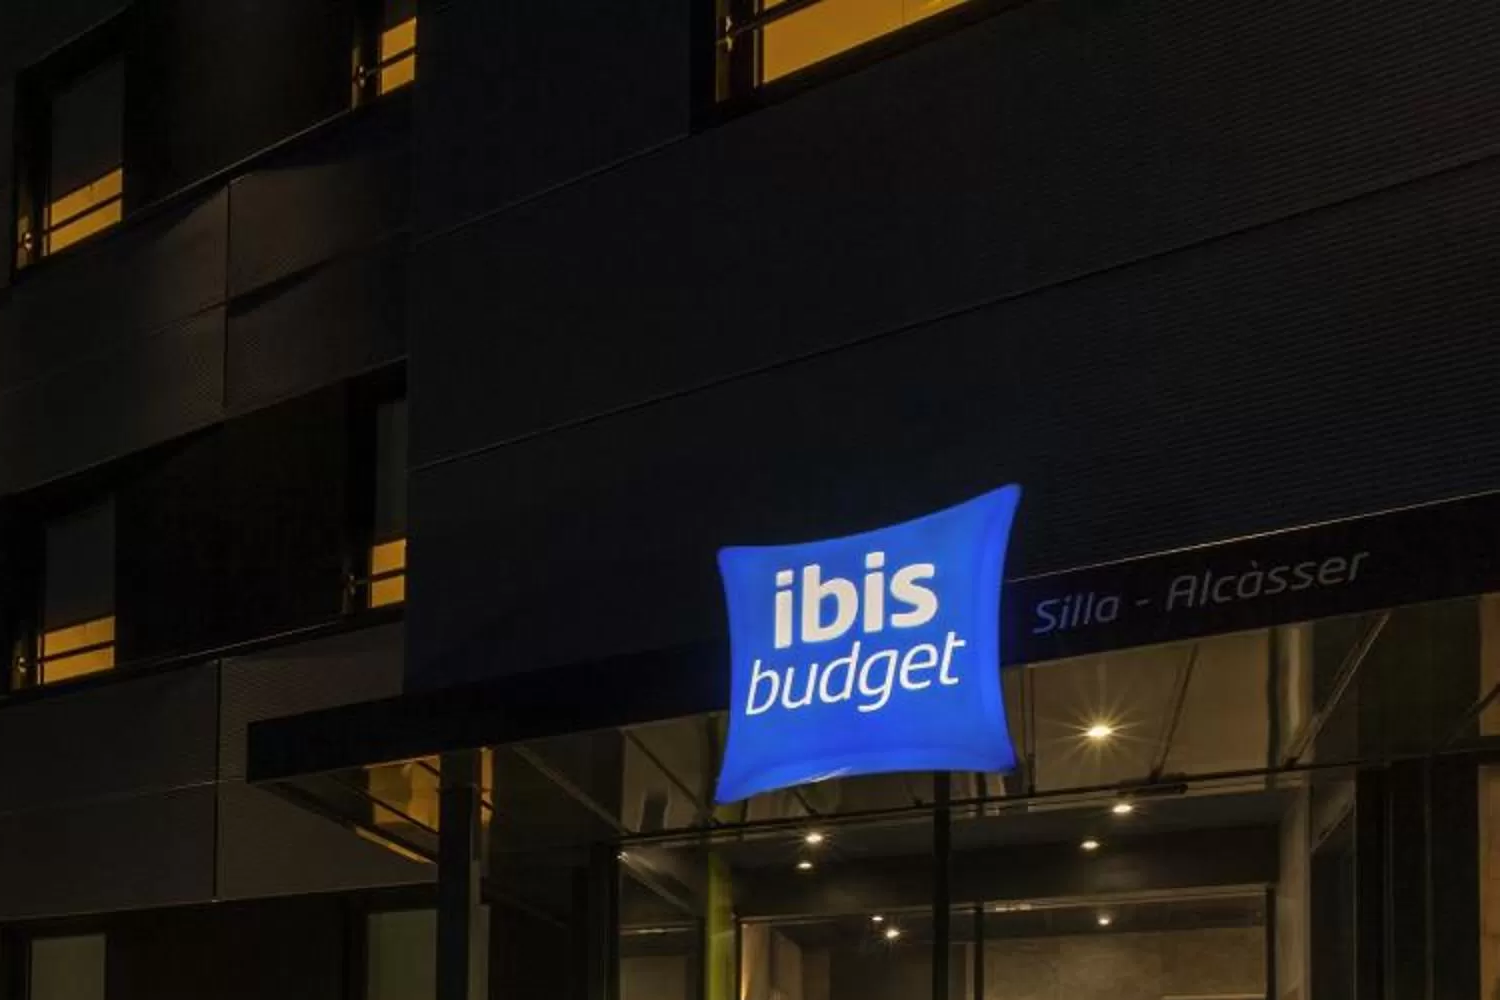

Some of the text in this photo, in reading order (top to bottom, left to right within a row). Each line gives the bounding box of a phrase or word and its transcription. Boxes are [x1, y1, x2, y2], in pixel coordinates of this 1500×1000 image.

[773, 551, 939, 648] ibis
[1032, 591, 1121, 635] Silla
[1164, 550, 1371, 612] Alcàsser
[744, 631, 967, 714] budget
